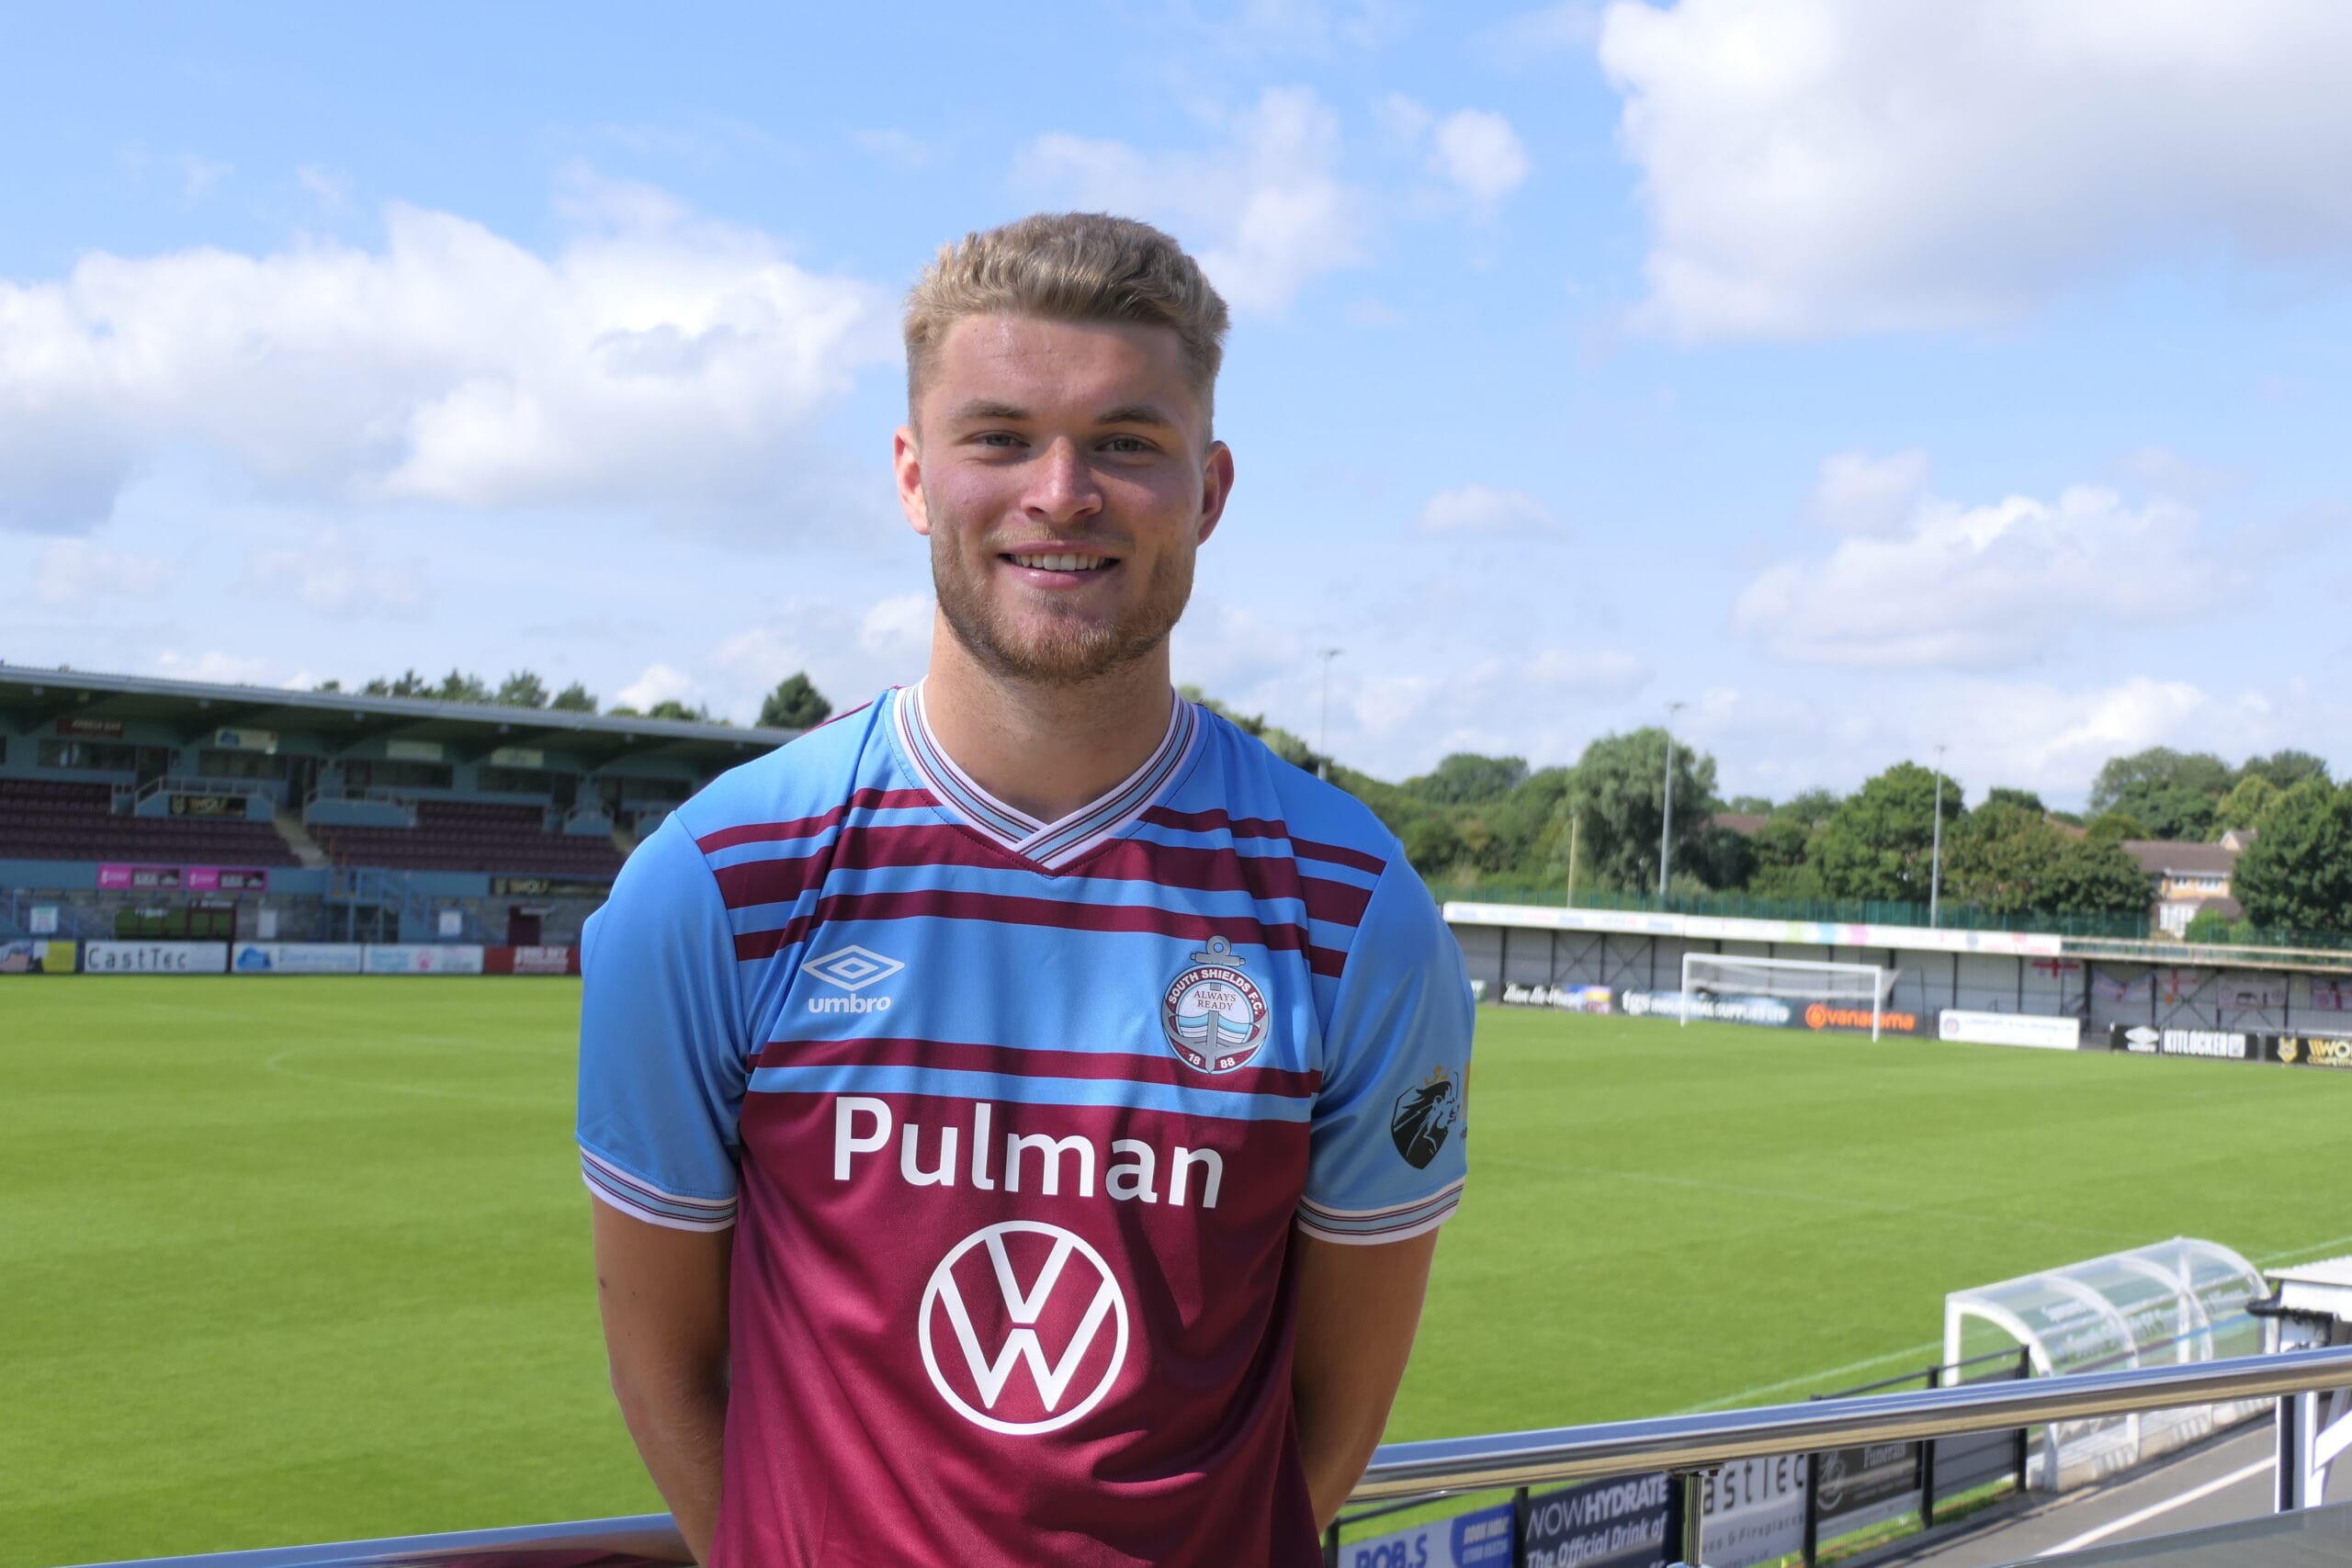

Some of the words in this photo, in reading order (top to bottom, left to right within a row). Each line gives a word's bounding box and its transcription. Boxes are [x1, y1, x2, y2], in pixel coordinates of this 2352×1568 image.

[88, 948, 187, 969] CastTec
[1168, 973, 1198, 1004] SOUTH
[1201, 969, 1251, 993] SHIELDS
[1248, 991, 1262, 1015] F.C.
[1193, 990, 1237, 1002] ALWAYS
[808, 993, 891, 1013] umbro
[1197, 999, 1233, 1010] READY
[2164, 1029, 2228, 1055] KITLOCKER
[2308, 1039, 2352, 1058] WO
[1188, 1054, 1201, 1065] 18
[1220, 1057, 1235, 1068] 88
[834, 1097, 1224, 1208] Pulman
[1526, 1549, 1556, 1568] The
[1557, 1529, 1608, 1568] Official
[1611, 1518, 1648, 1551] Drink
[1651, 1511, 1668, 1542] of
